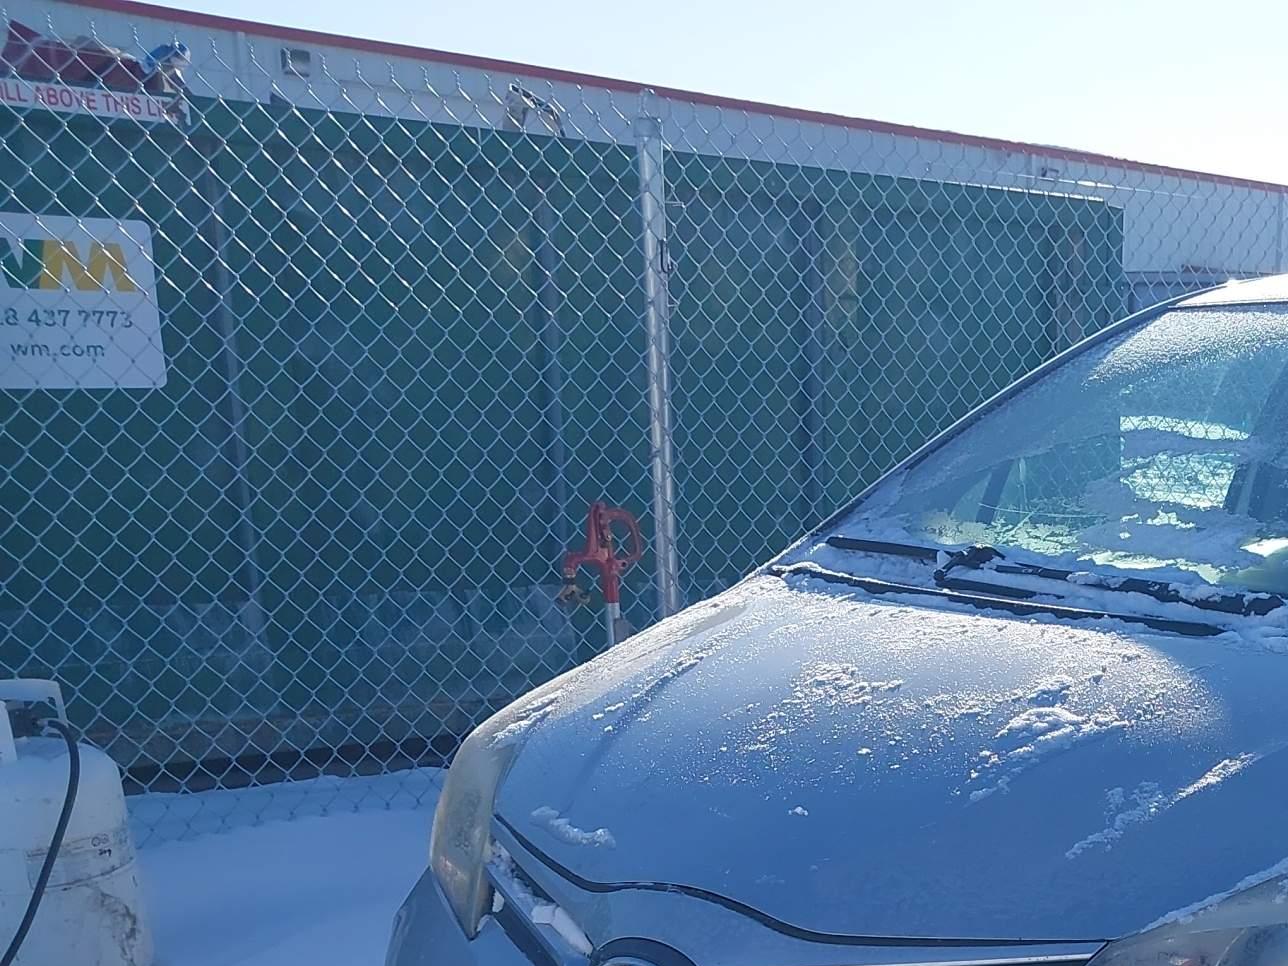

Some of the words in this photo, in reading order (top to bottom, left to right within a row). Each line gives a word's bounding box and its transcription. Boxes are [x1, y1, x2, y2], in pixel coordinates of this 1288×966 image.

[34, 85, 97, 111] ABOVE
[101, 94, 143, 116] THIS
[26, 308, 71, 327] 437
[78, 309, 133, 328] 7773
[10, 344, 105, 358] wm.com
